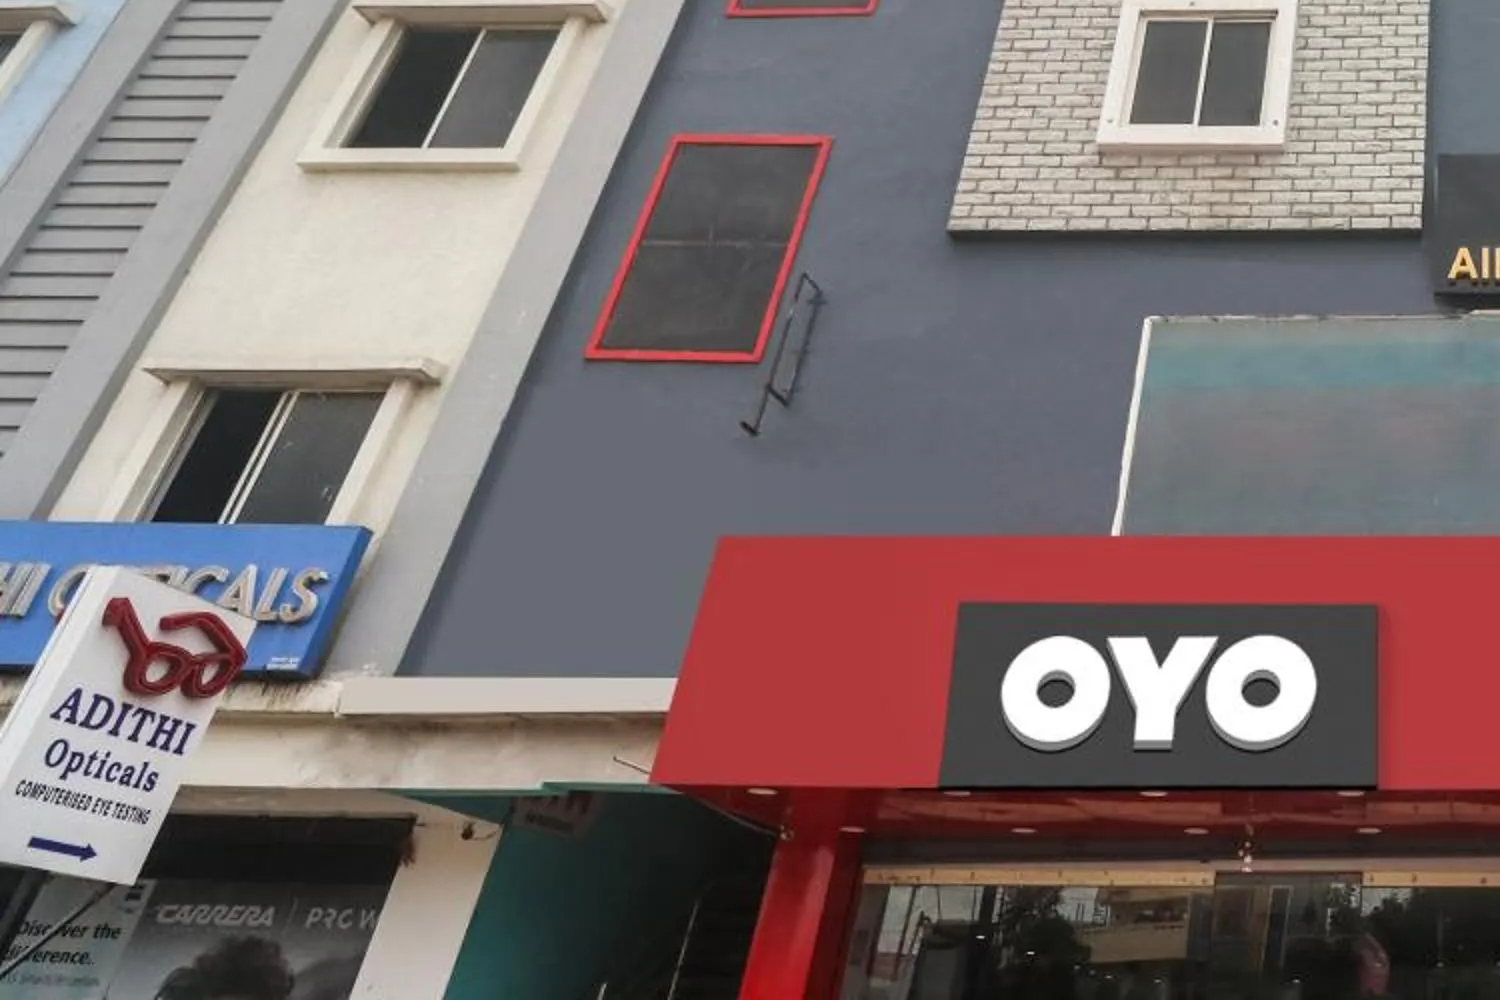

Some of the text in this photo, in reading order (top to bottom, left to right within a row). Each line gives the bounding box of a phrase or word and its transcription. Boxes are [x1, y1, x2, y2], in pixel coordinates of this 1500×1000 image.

[48, 563, 330, 624] OCALS
[1001, 634, 1318, 753] OYO
[50, 687, 197, 756] ADITHI
[44, 738, 160, 793] Opticals
[15, 779, 151, 825] COMPUTERISED EYE TESTING
[19, 920, 122, 939] Discver the
[155, 904, 275, 928] CARRERA
